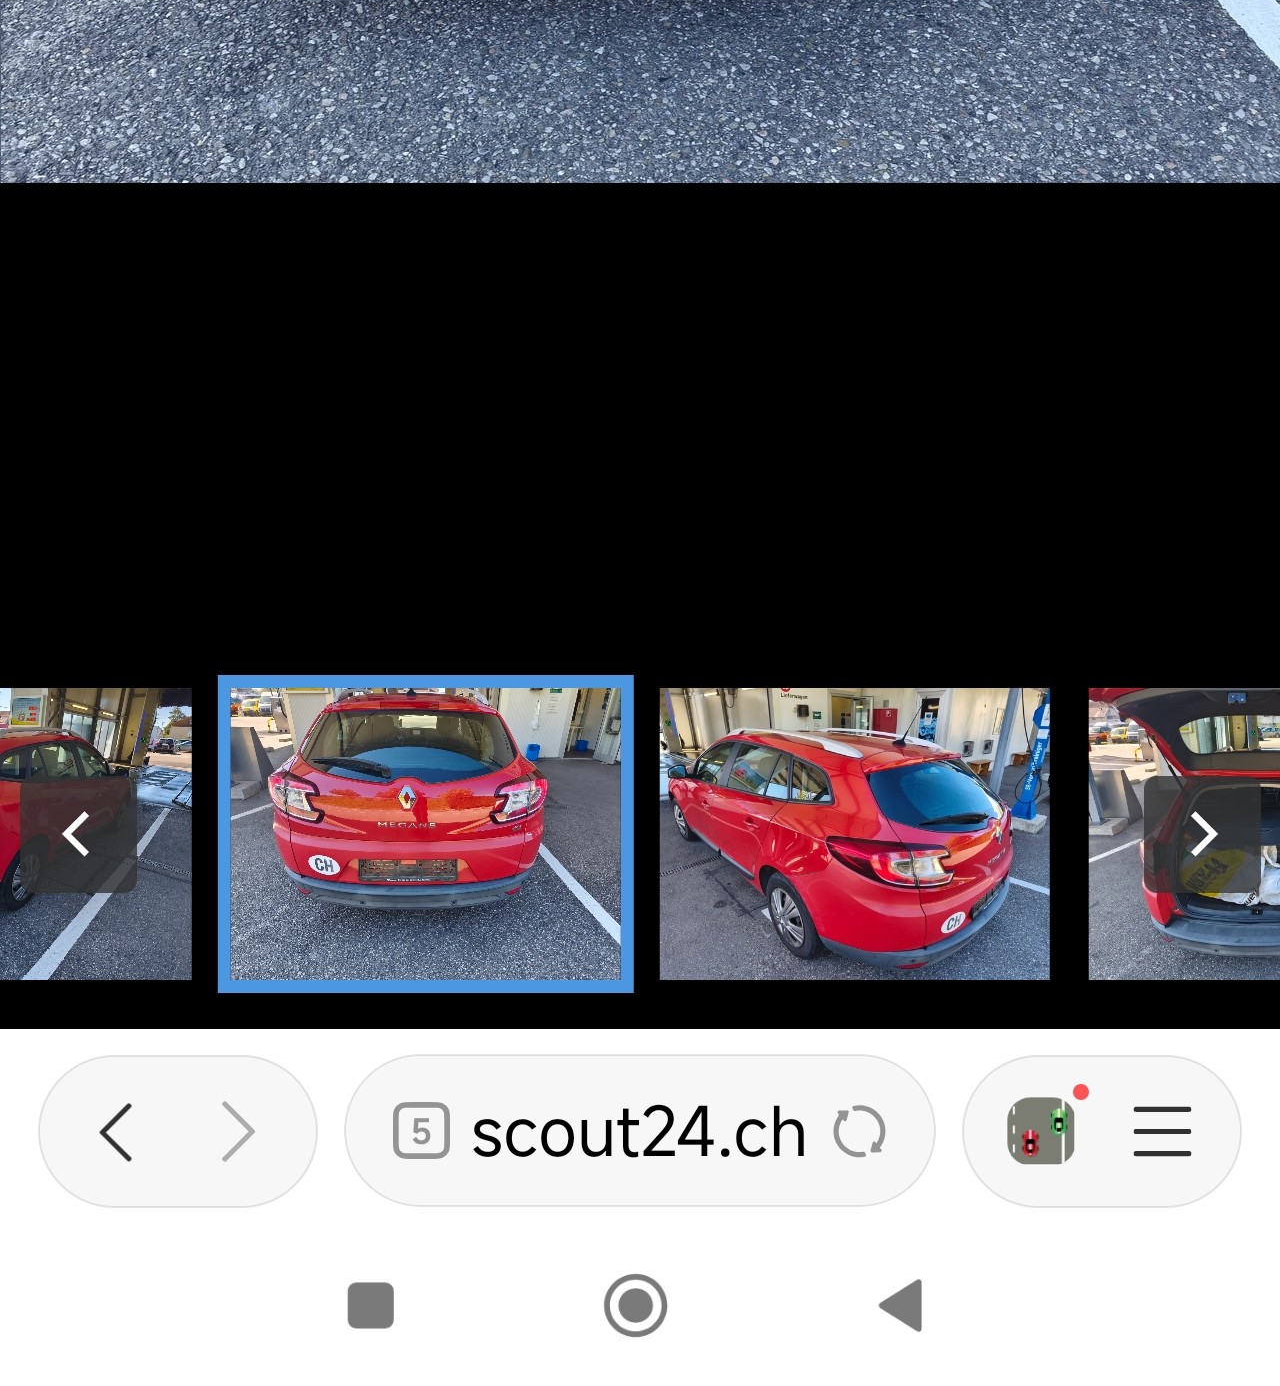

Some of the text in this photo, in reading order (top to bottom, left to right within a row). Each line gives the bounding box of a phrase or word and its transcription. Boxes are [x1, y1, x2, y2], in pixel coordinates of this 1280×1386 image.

[377, 821, 436, 829] MEGANE
[314, 857, 335, 873] CH
[946, 914, 963, 931] CH
[412, 1104, 806, 1158] 5 scout24.ch
